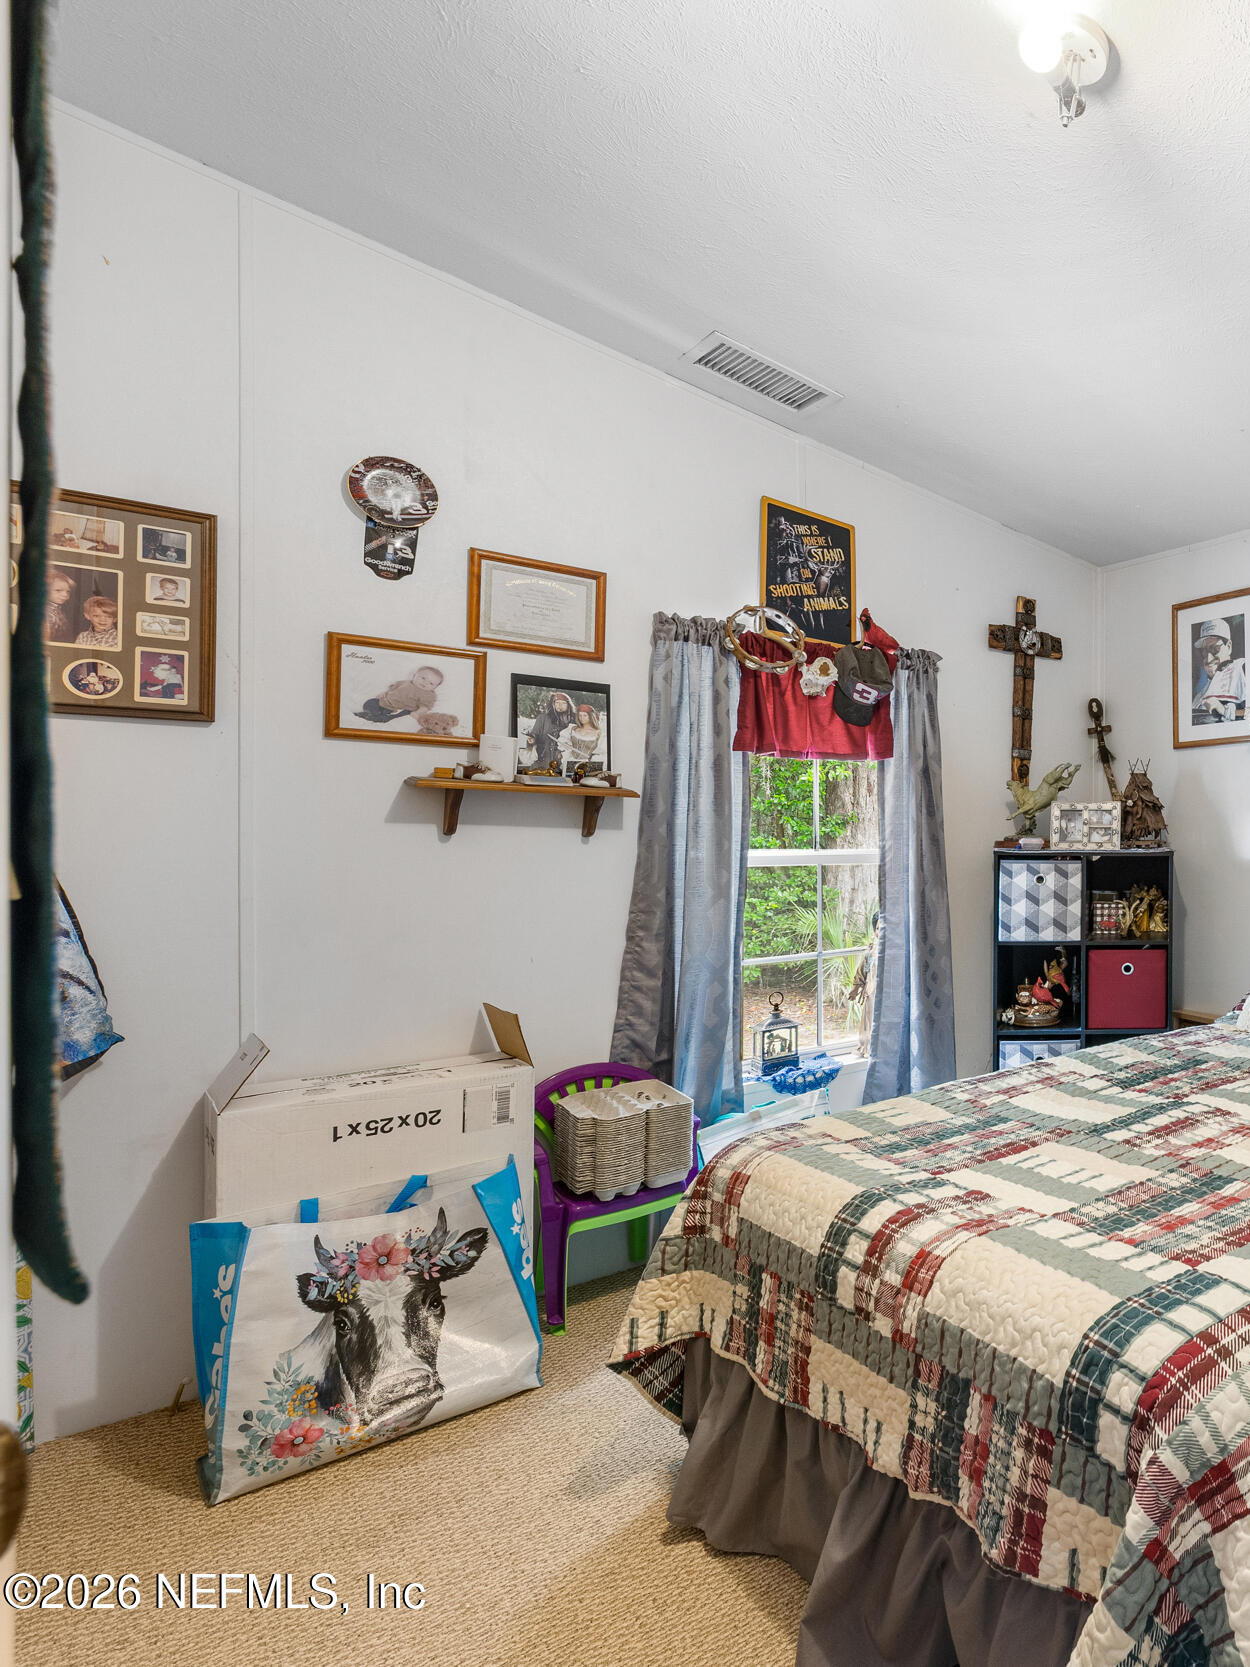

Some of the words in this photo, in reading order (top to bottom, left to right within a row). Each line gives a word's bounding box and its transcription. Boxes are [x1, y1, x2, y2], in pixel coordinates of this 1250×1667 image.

[793, 524, 811, 535] THIS
[811, 525, 820, 535] IS
[802, 536, 827, 546] WHERE
[828, 536, 832, 546] I
[811, 548, 844, 561] STAND
[800, 568, 812, 579] ON
[769, 583, 817, 597] SHOOTING
[804, 597, 848, 611] ANIMALS
[852, 682, 880, 705] 3
